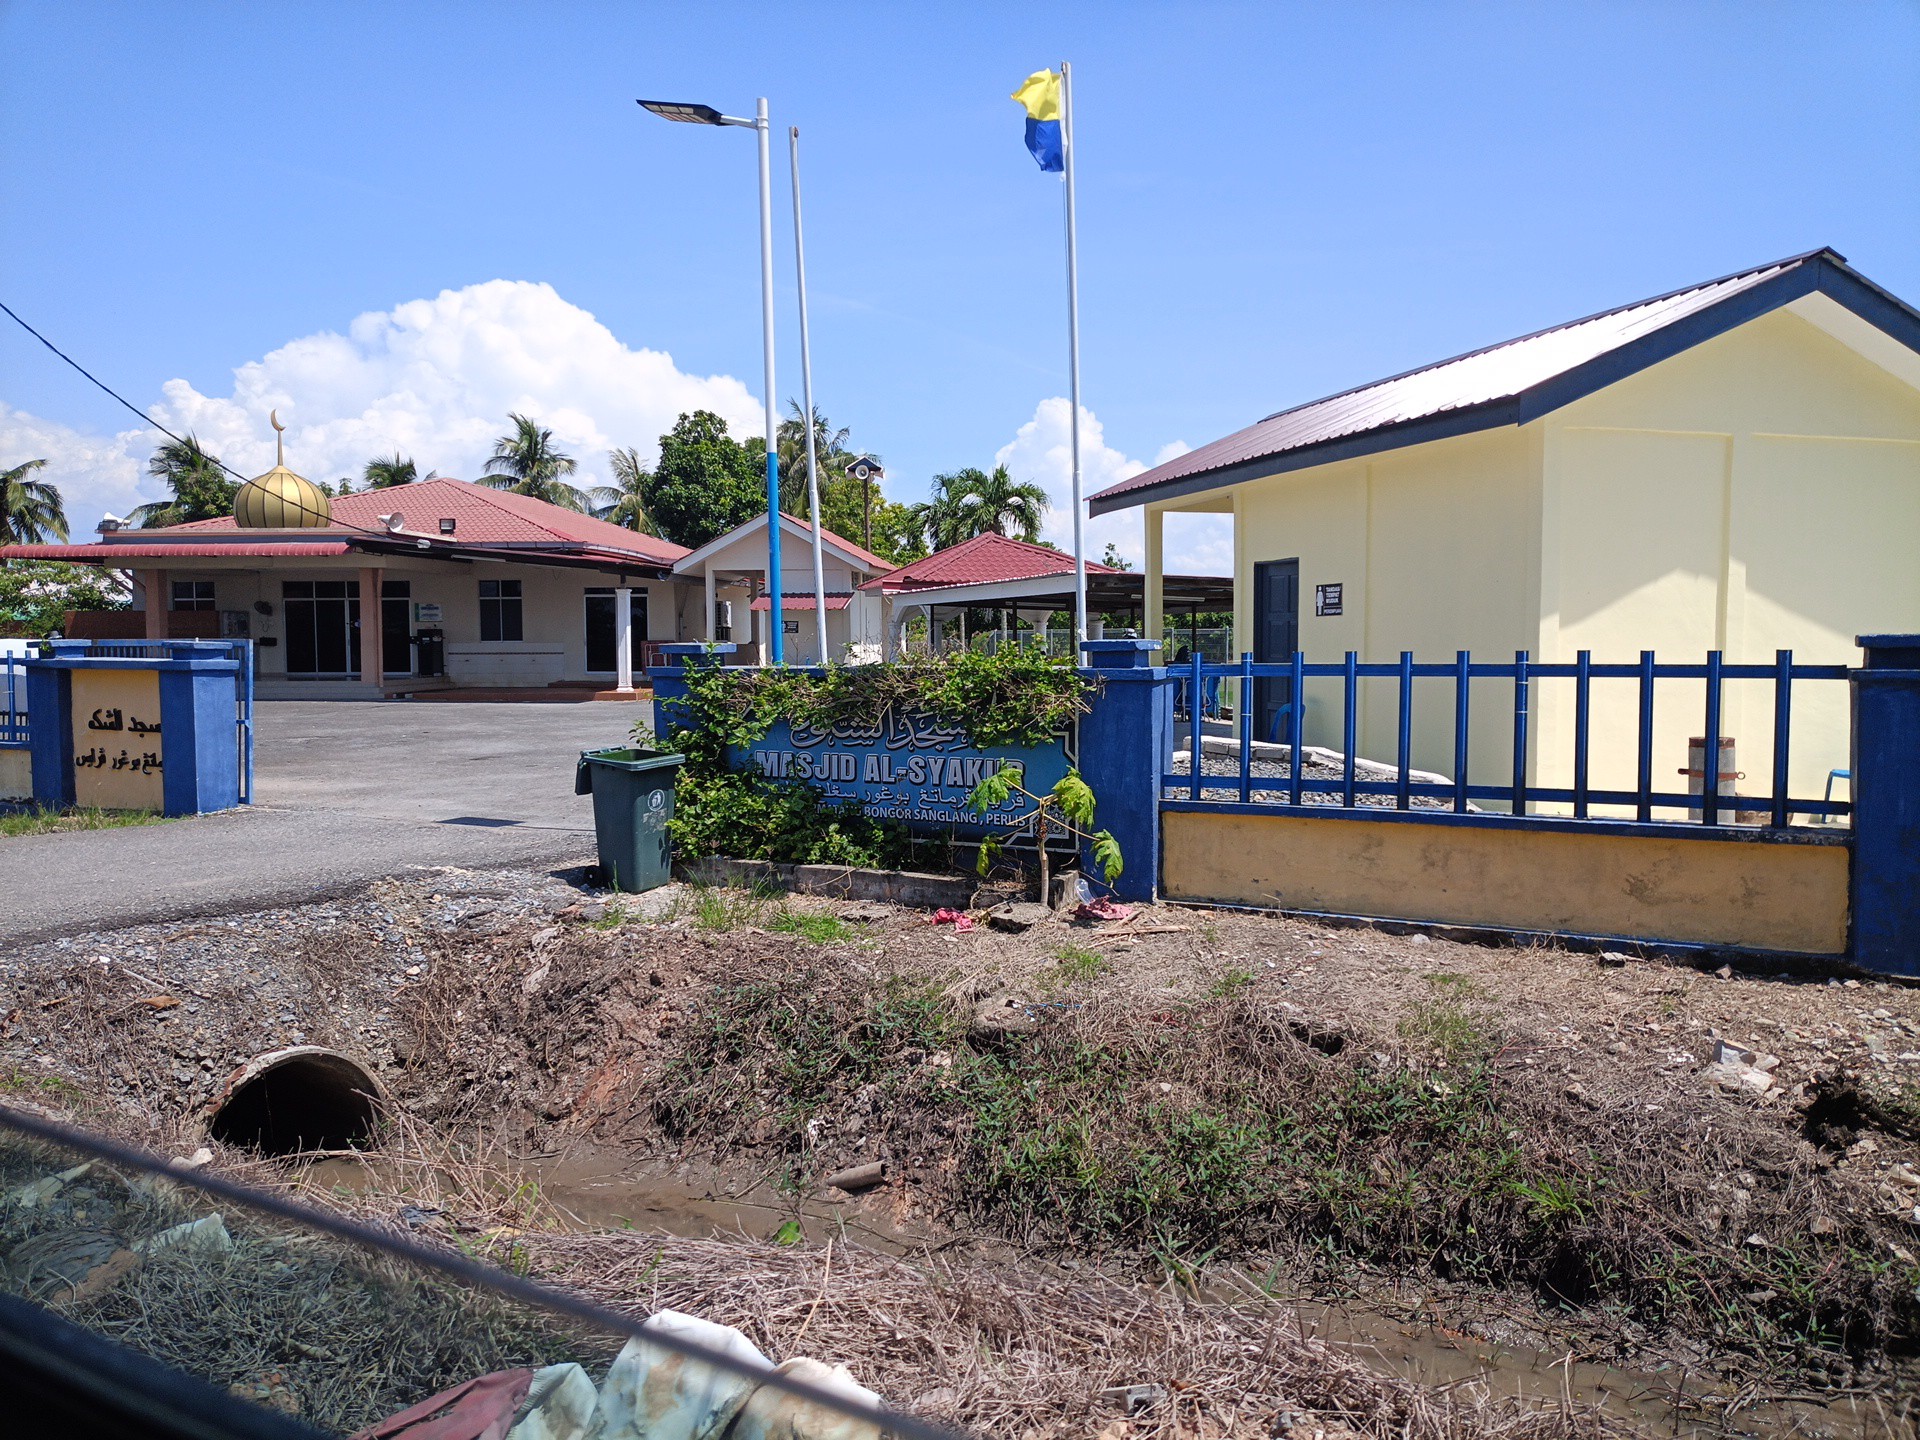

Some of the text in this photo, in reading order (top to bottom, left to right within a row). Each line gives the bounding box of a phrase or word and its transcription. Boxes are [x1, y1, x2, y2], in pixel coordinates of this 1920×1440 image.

[128, 717, 162, 738] سجد
[754, 750, 858, 783] MASJID
[864, 806, 912, 820] BONGOR
[914, 808, 978, 823] SANGLANG
[986, 813, 1026, 827] PERLIS
